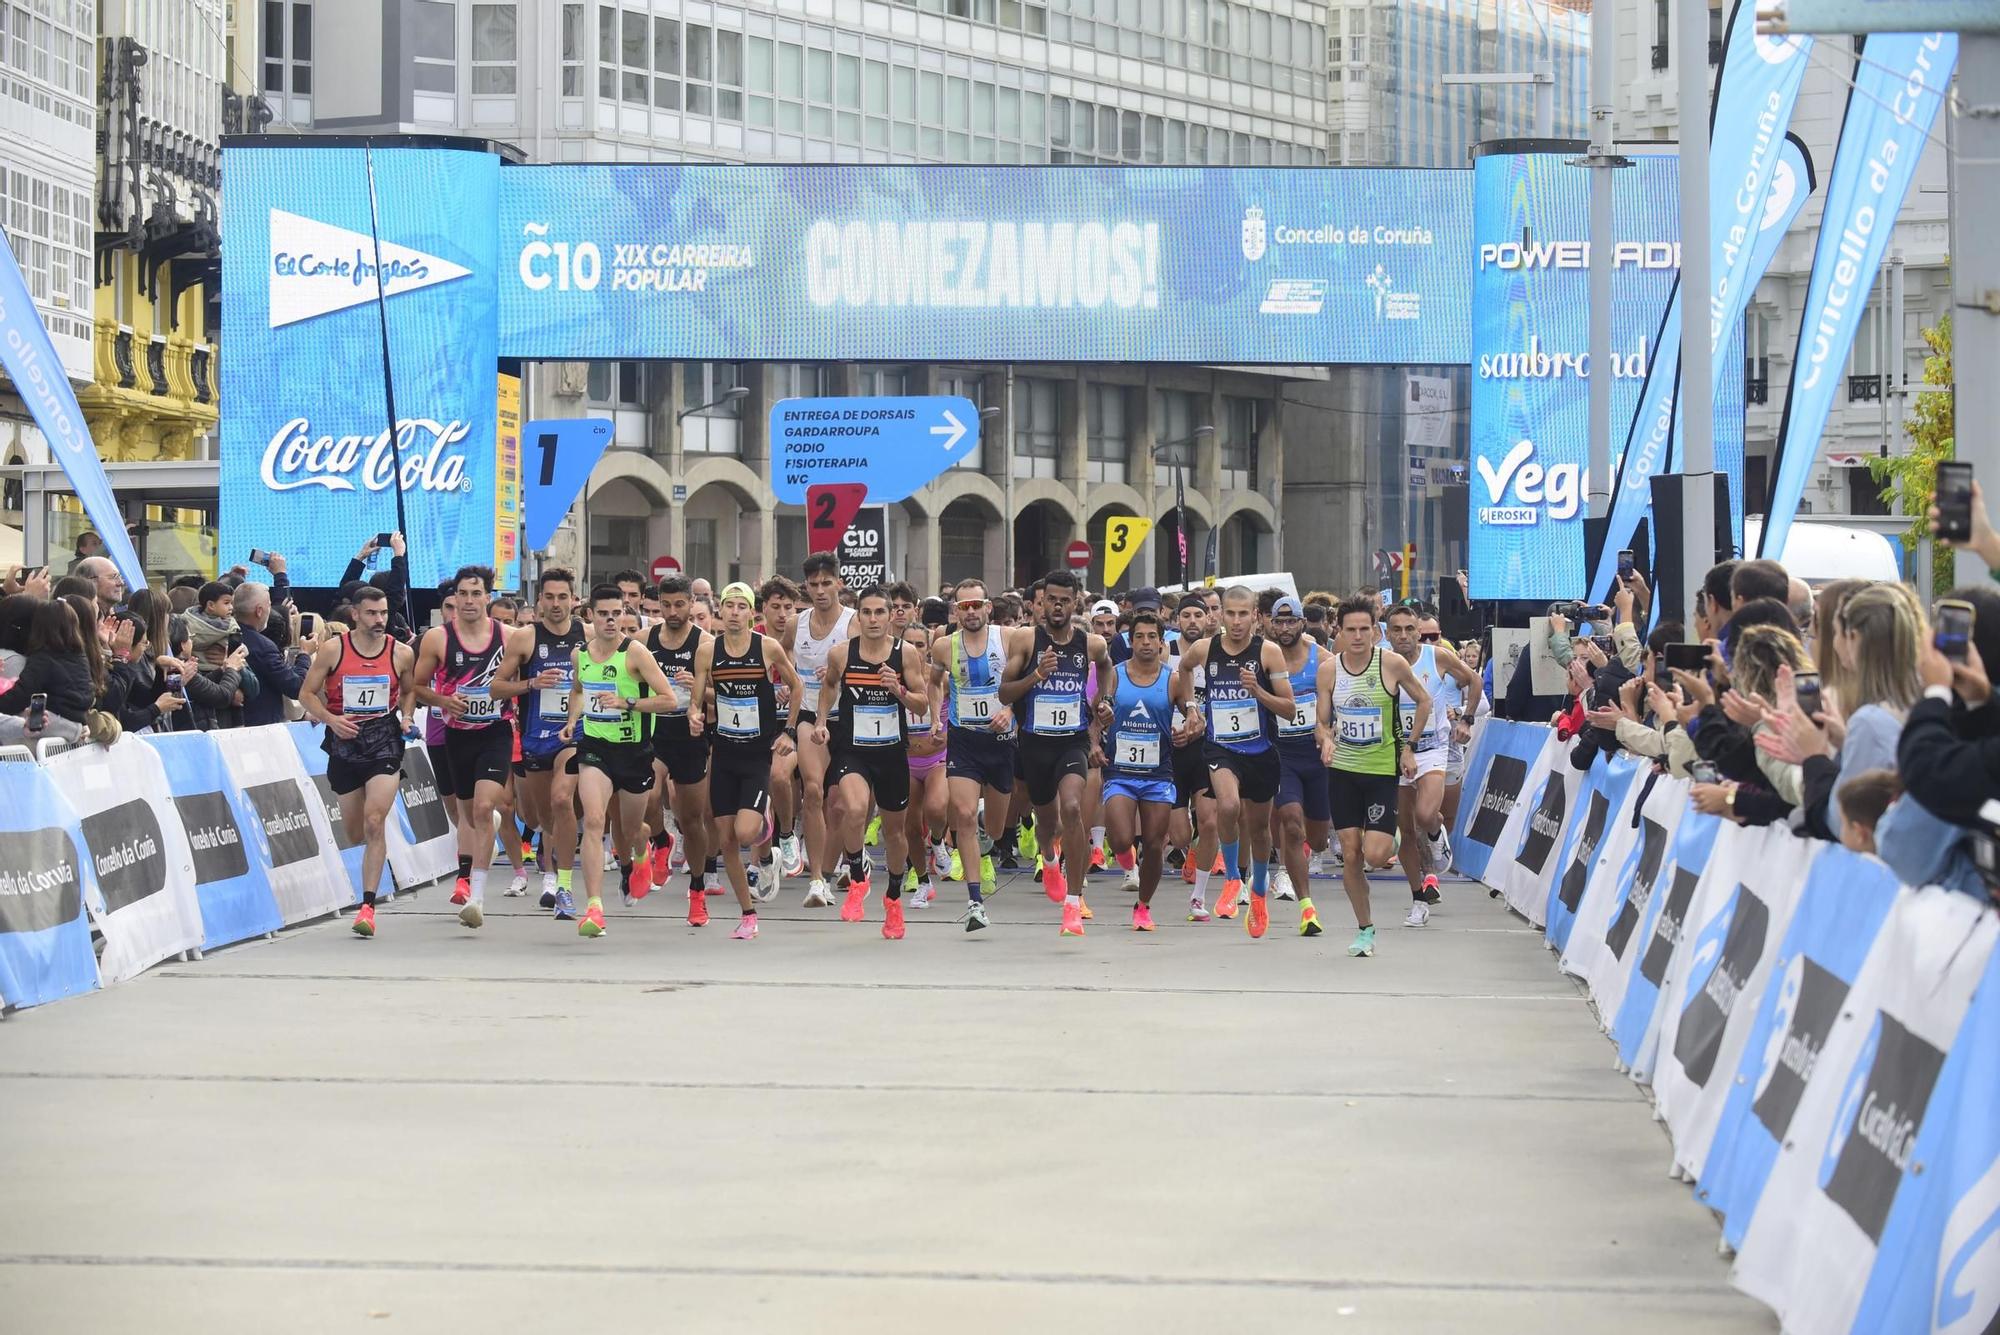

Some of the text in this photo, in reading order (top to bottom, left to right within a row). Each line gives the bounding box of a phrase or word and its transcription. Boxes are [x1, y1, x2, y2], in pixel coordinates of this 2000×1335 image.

[1869, 138, 1899, 194] da
[1892, 33, 1944, 127] Coru
[1722, 224, 1747, 266] da
[1736, 90, 1781, 216] Coruña
[1274, 225, 1432, 245] Concello da Coruña
[612, 244, 752, 268] XIX CARREIRA
[1480, 241, 1681, 270] POWEAD
[274, 252, 296, 276] El
[300, 254, 351, 276] Corte
[807, 220, 1160, 308] COMEZAMOS!
[612, 269, 707, 292] POPULAR
[784, 409, 916, 421] ENTREGA DE DORSAIS
[784, 426, 880, 438] GARDARROUPA
[785, 442, 825, 454] PODIO
[1626, 396, 1673, 490] Concell
[260, 418, 471, 492] Coca-Cola
[538, 433, 559, 486] 1
[785, 457, 869, 469] FISIOTERAPIA
[787, 474, 809, 485] WC
[813, 492, 837, 529] 2
[1491, 509, 1533, 521] EROSKI
[1111, 524, 1129, 553] 3
[840, 565, 884, 576] 05.OUT
[845, 575, 879, 589] 2025
[358, 690, 375, 706] 47
[1210, 688, 1252, 700] NARO
[973, 701, 988, 717] 10
[732, 713, 741, 728] 4
[1051, 710, 1067, 726] 19
[1231, 716, 1240, 732] 3
[874, 720, 881, 736] 1
[1342, 720, 1375, 738] 8511
[1129, 747, 1145, 763] 31
[122, 841, 136, 866] da
